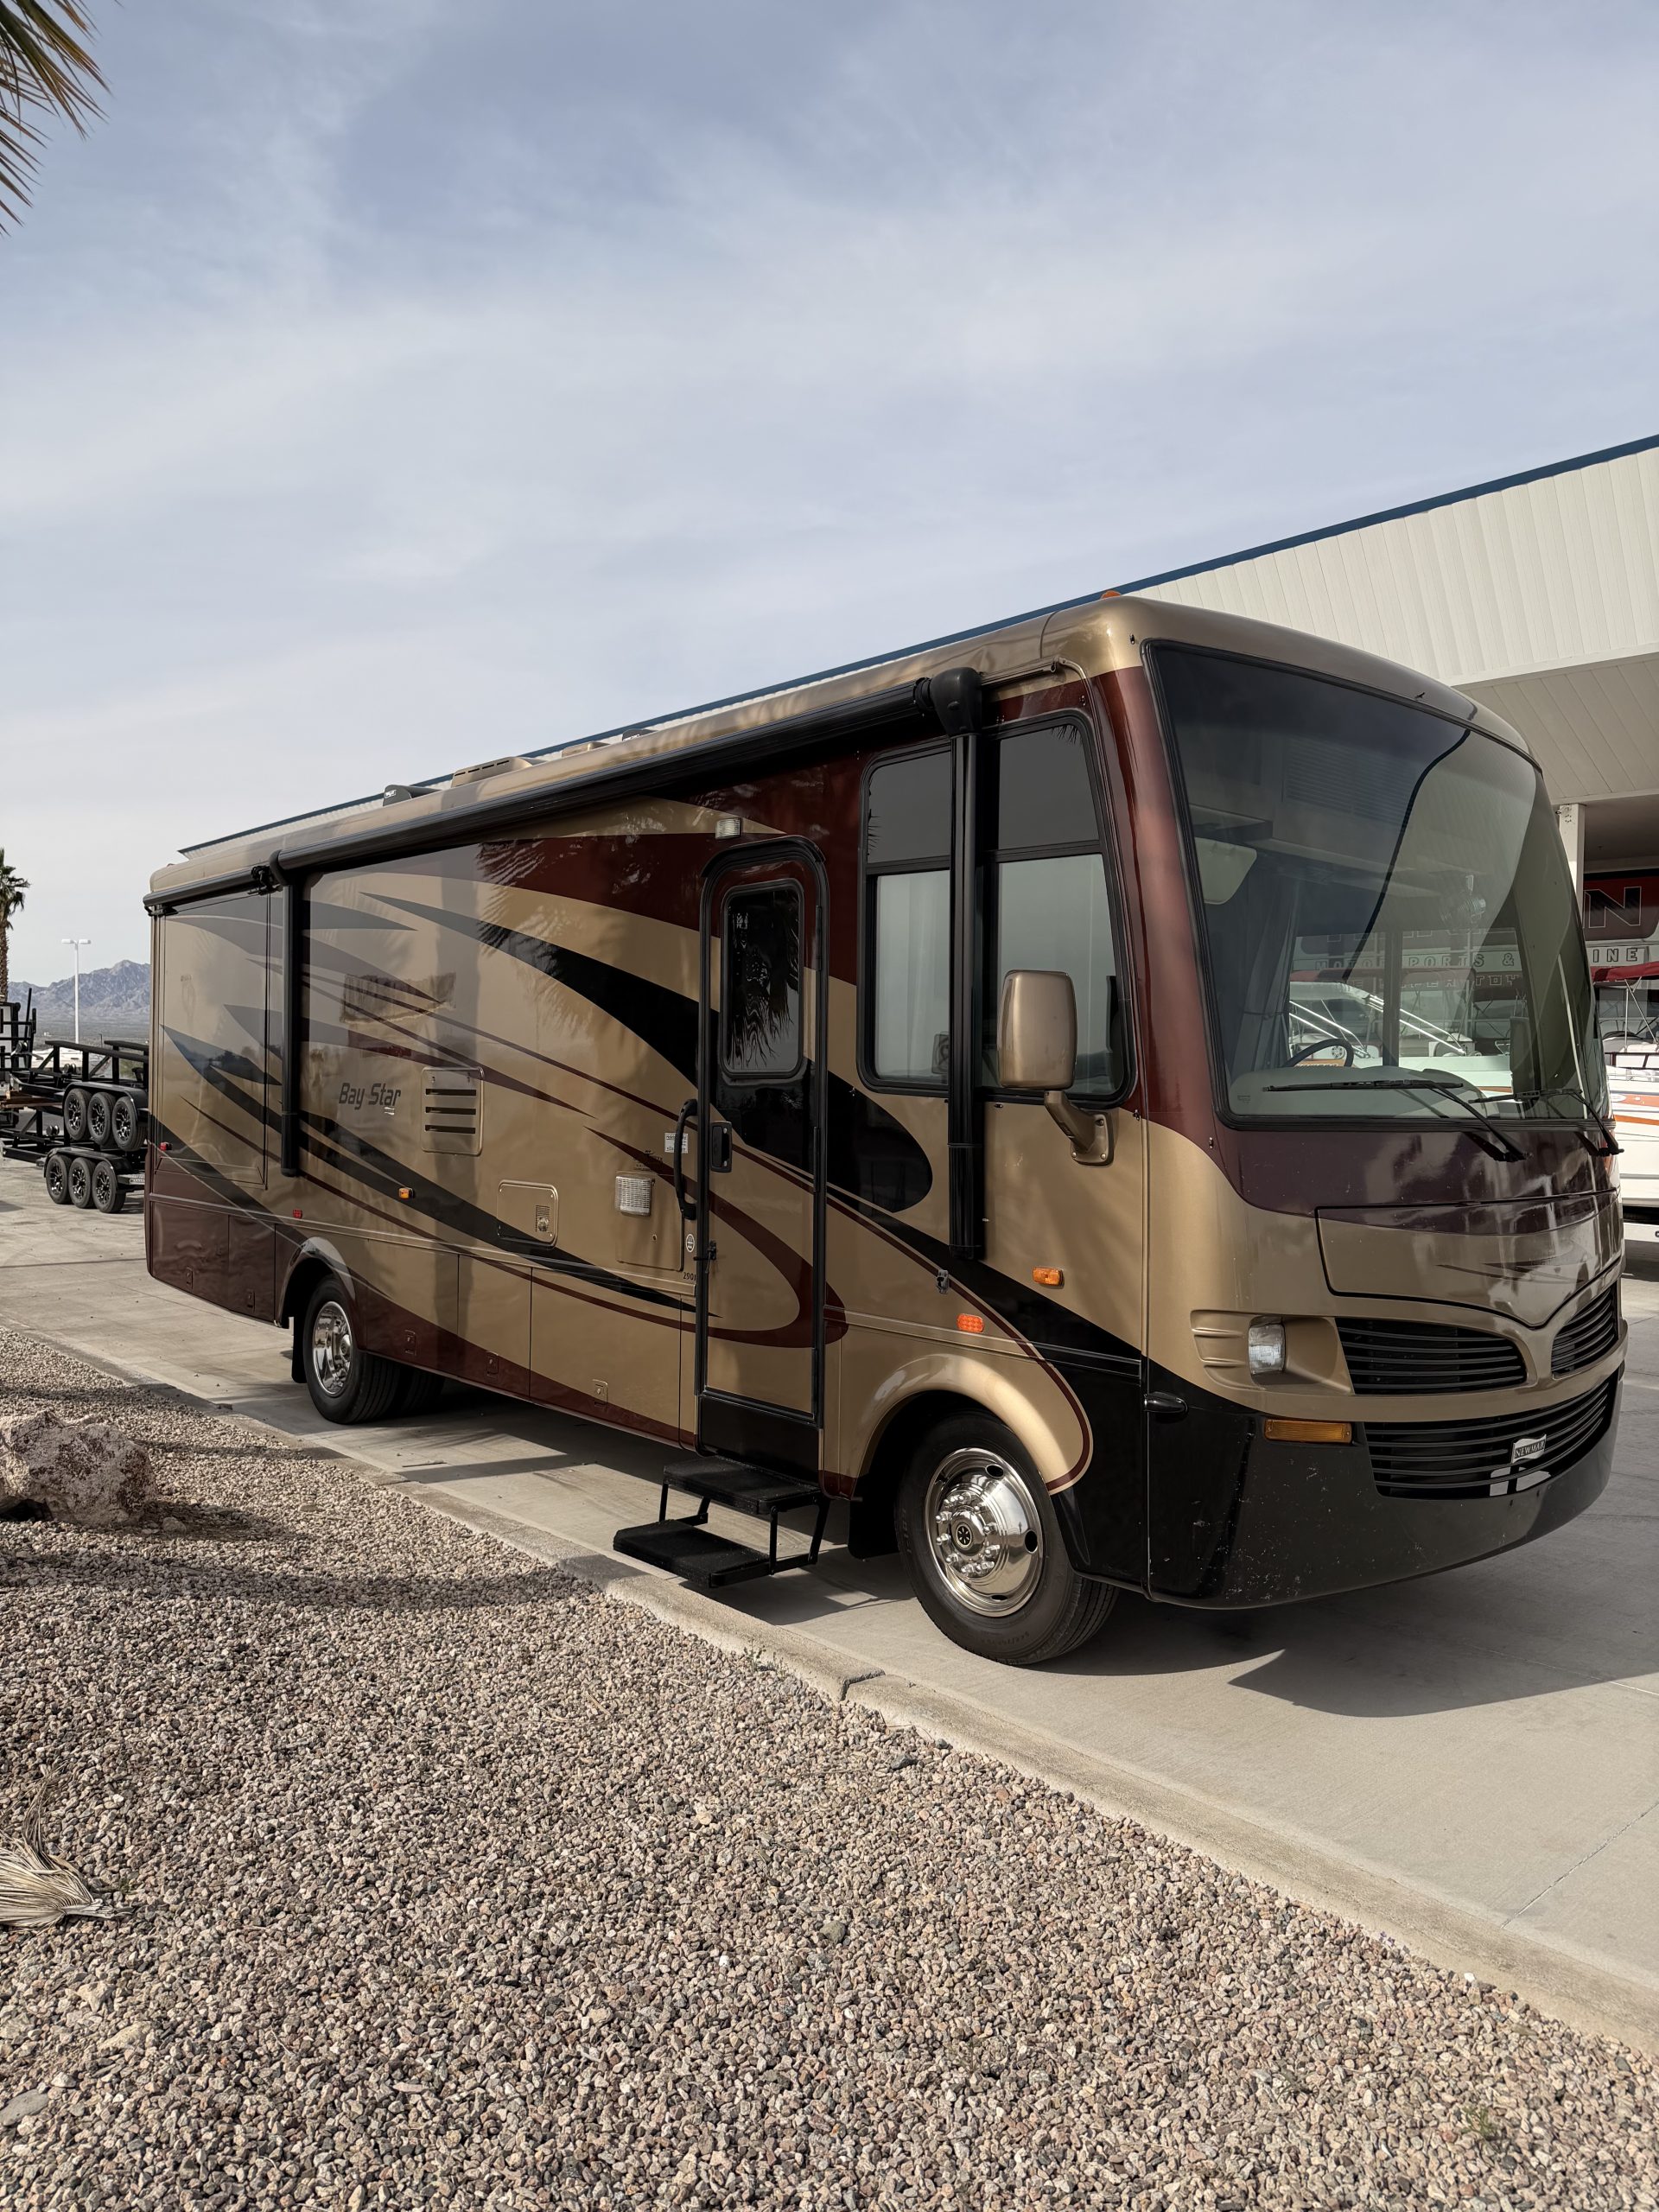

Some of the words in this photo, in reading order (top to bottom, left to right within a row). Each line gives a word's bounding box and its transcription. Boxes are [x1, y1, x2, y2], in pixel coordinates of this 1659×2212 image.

[1502, 952, 1515, 967] &
[1592, 948, 1638, 963] INE
[339, 1083, 365, 1110] Bay
[368, 1083, 401, 1106] Star
[1514, 1440, 1545, 1459] NEWMAR
